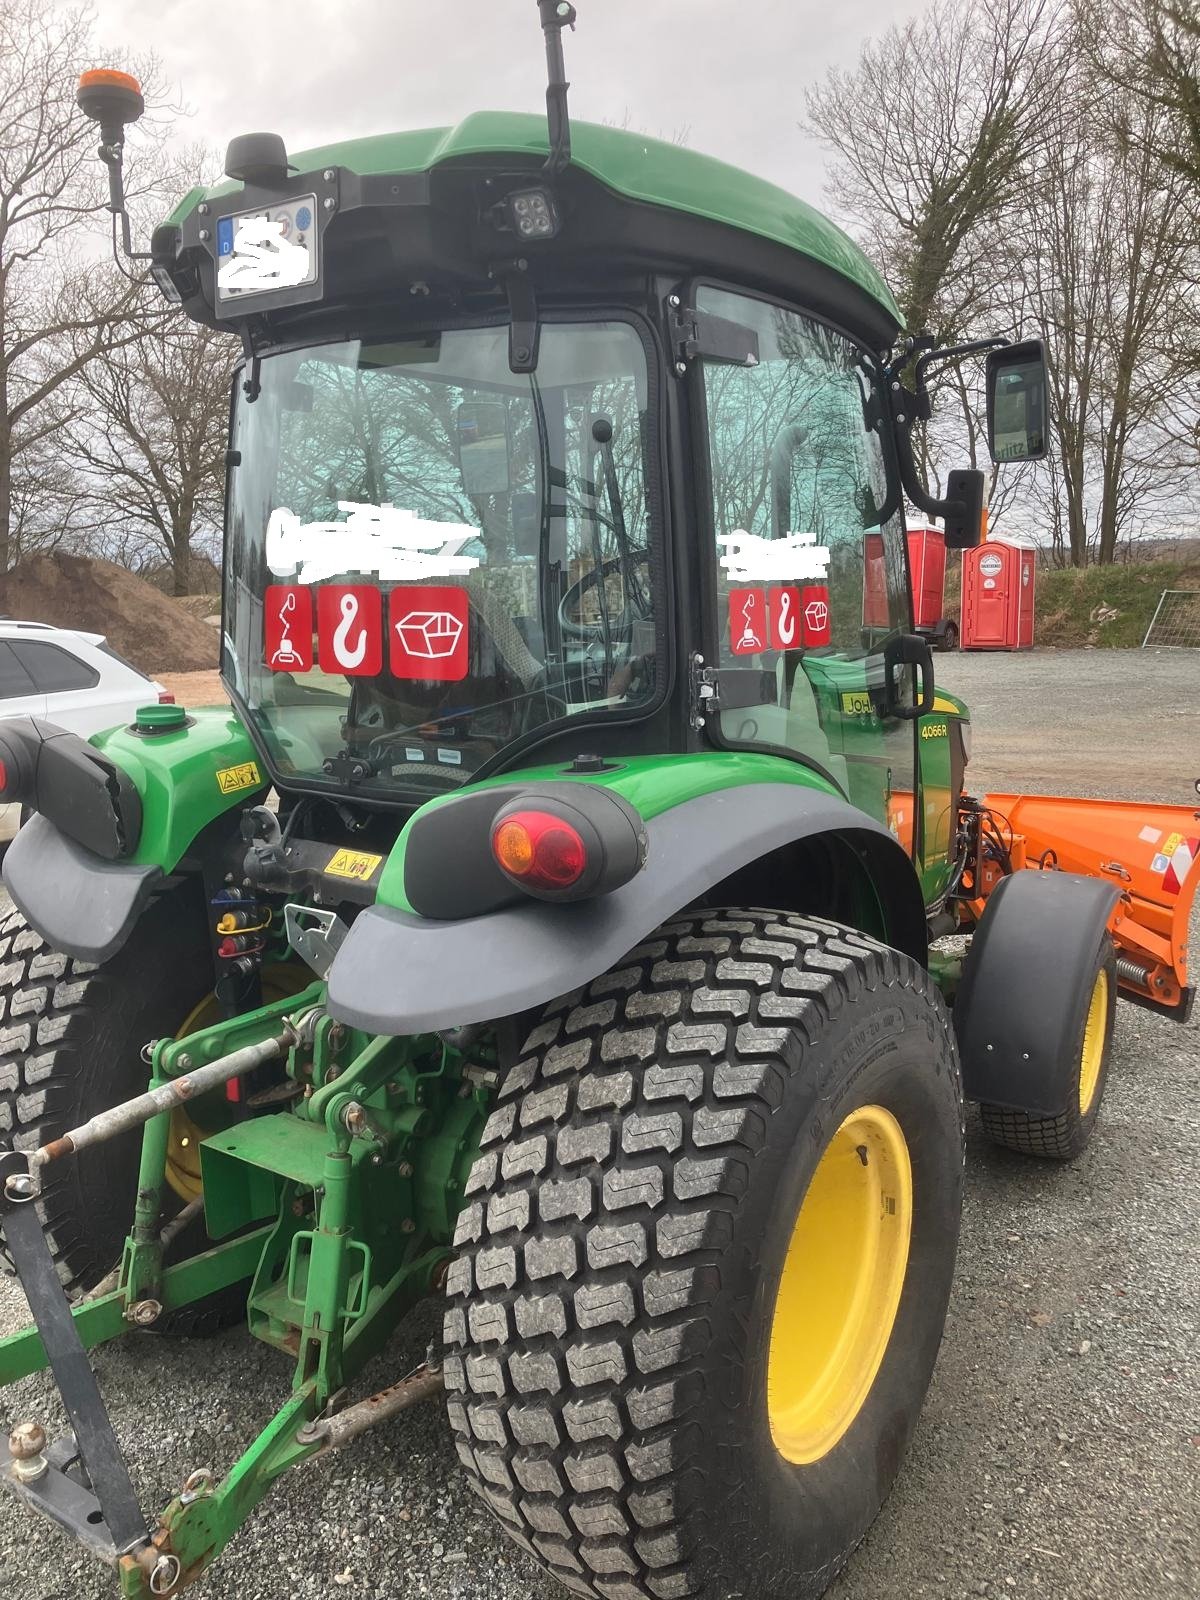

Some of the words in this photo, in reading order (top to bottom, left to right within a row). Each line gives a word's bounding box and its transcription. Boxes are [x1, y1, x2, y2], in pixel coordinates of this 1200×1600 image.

[223, 242, 230, 253] D
[848, 697, 871, 713] JOH
[922, 724, 947, 739] 4066R
